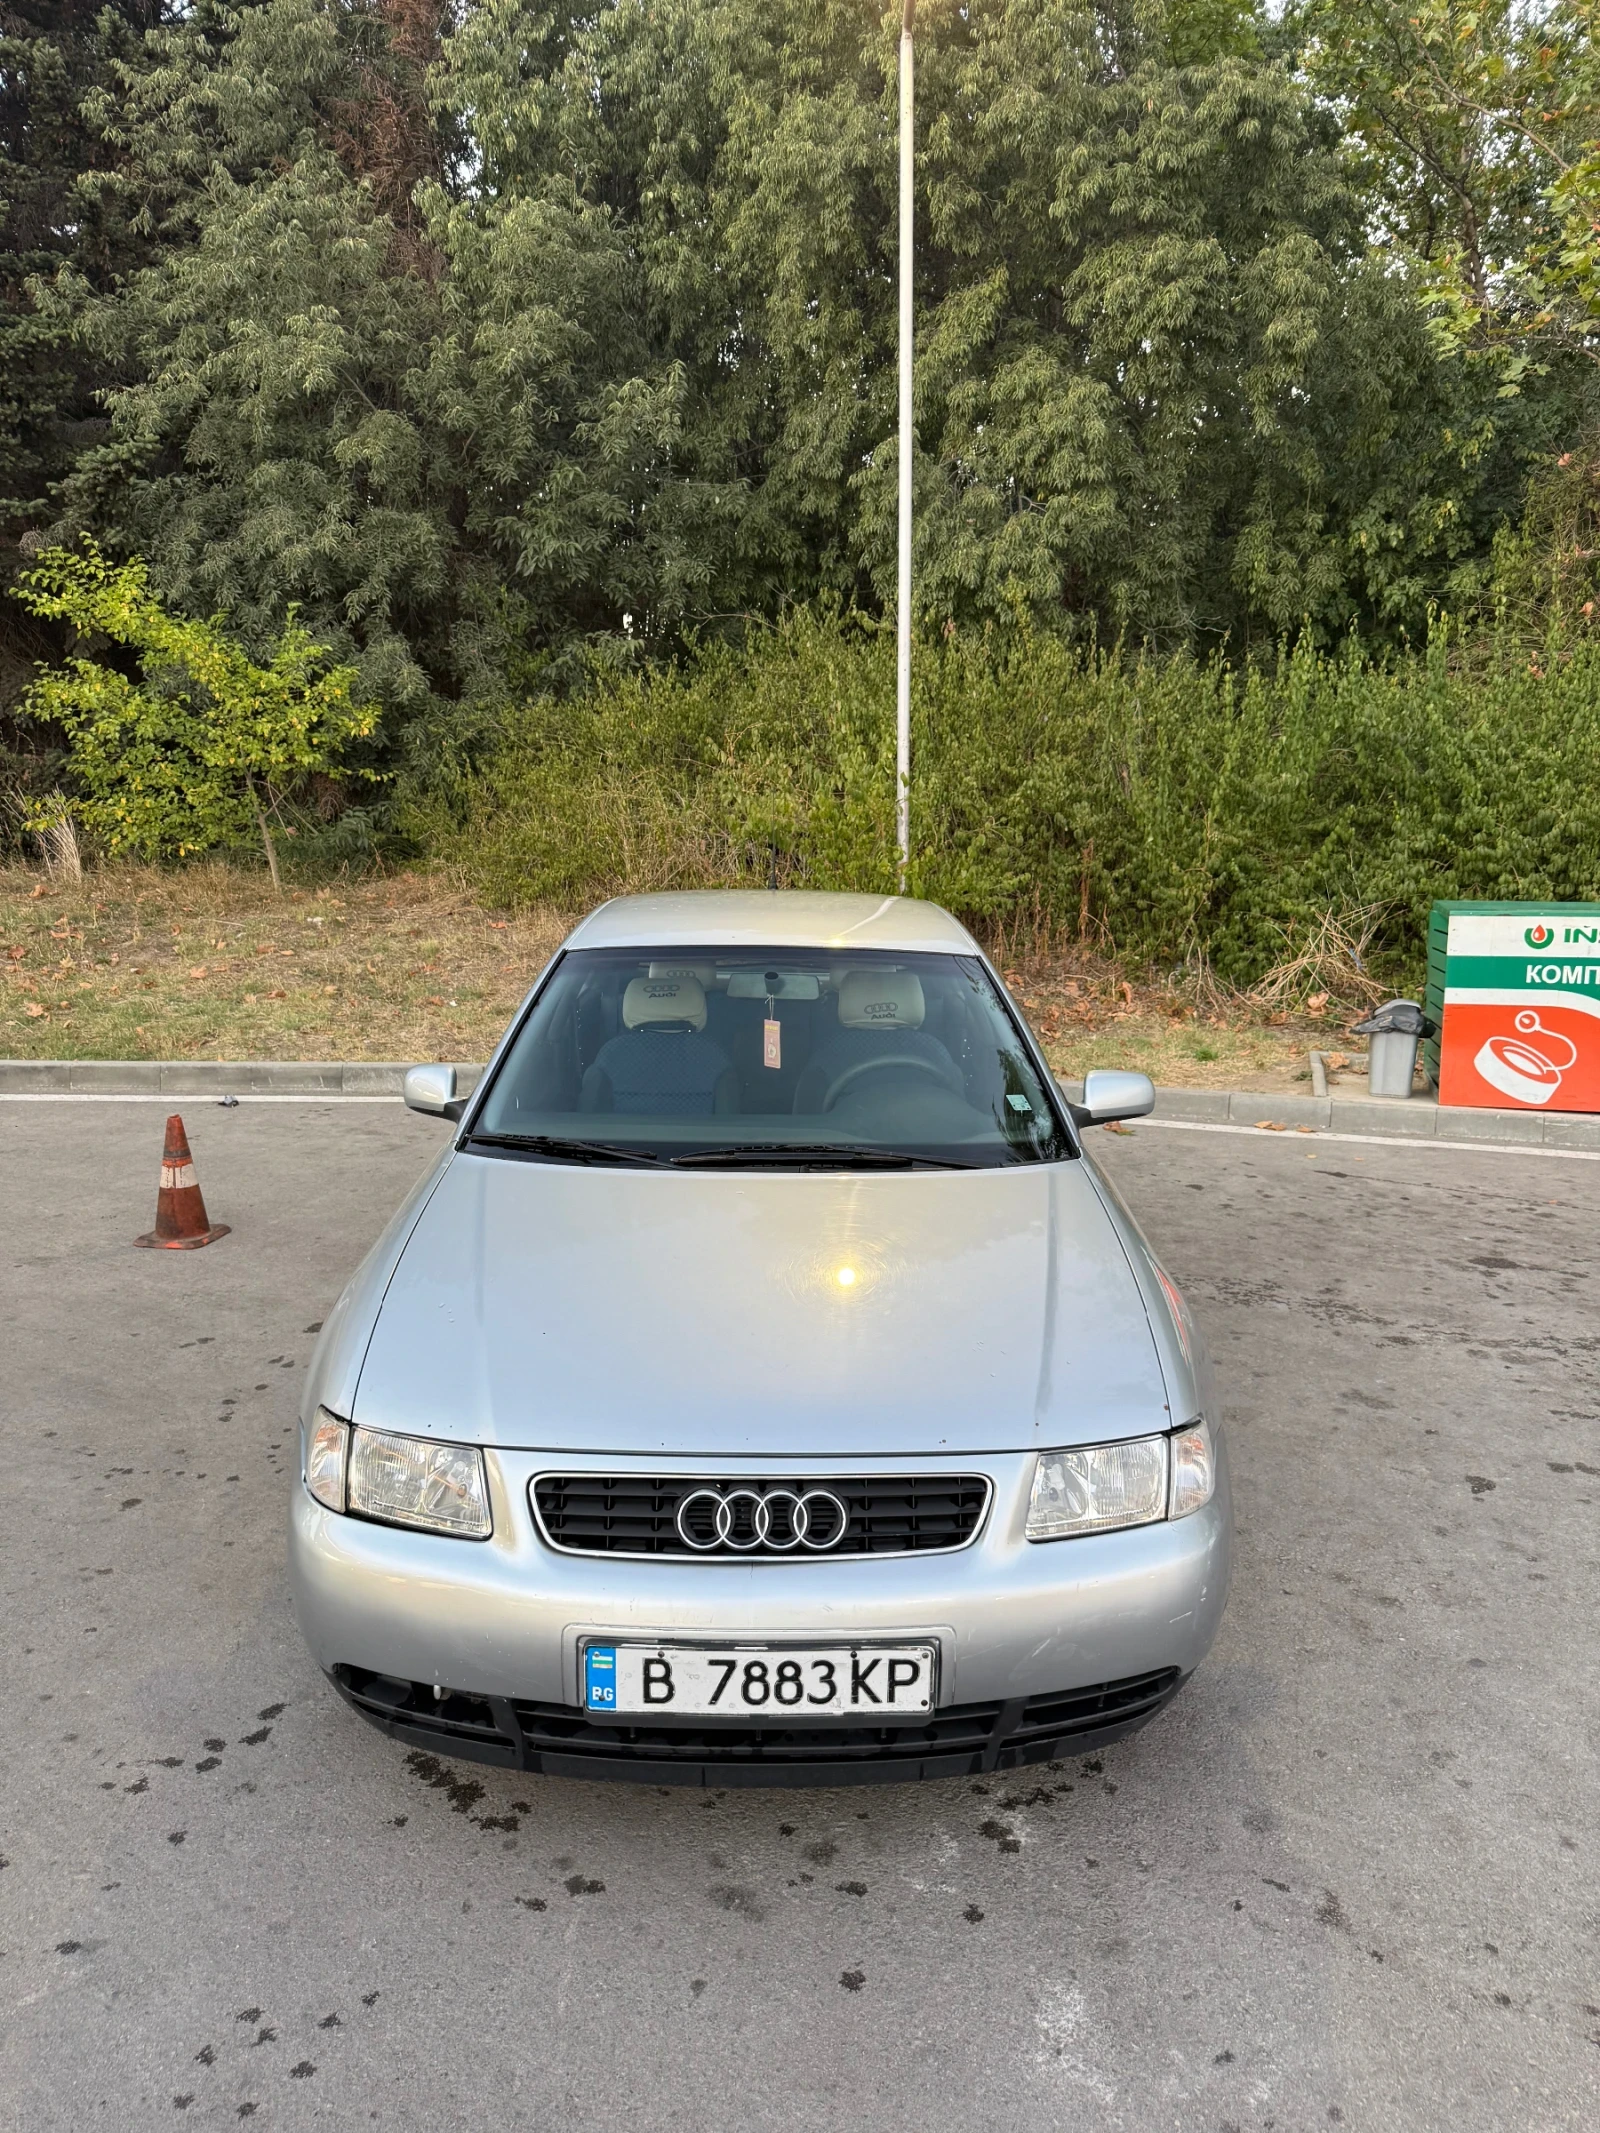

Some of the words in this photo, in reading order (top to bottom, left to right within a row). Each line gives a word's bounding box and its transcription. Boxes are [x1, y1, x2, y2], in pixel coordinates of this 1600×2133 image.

[1564, 928, 1600, 943] IN
[1526, 964, 1600, 985] КОМП
[871, 1012, 896, 1020] Audi
[643, 1657, 675, 1704] B
[707, 1659, 838, 1705] 7883
[851, 1658, 920, 1704] KP
[592, 1686, 614, 1701] BG
